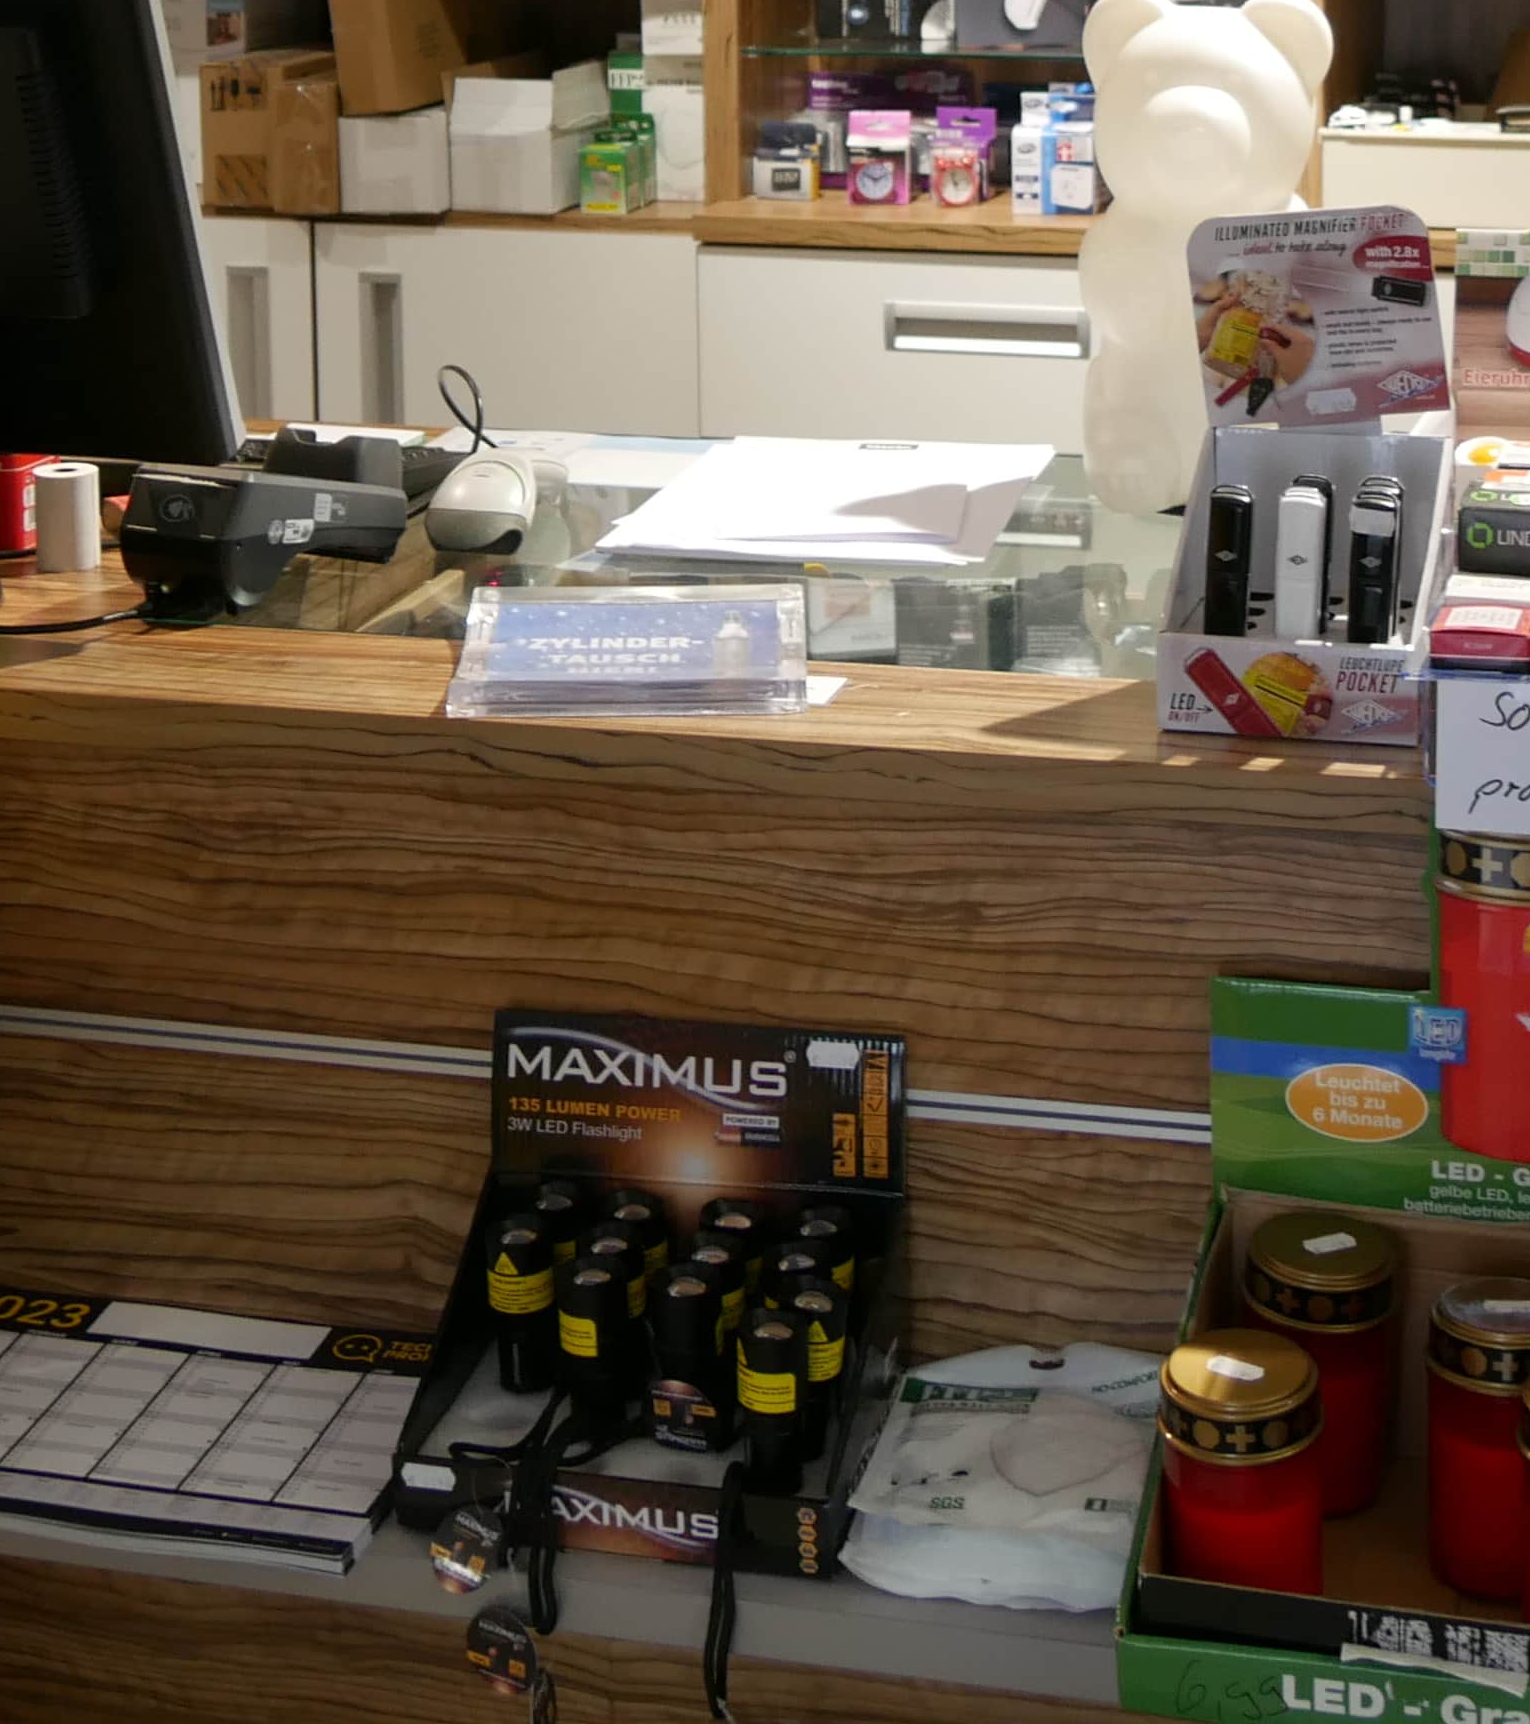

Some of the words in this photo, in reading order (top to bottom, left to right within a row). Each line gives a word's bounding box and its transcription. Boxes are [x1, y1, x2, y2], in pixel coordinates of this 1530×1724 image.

[1215, 222, 1289, 242] ILLUMINATED
[1294, 218, 1358, 235] MAGNIFIER
[1365, 246, 1391, 258] with
[1463, 371, 1530, 387] Eieruhr
[550, 652, 681, 664] TAUSCH
[1340, 657, 1404, 672] LEUCHTLUPE
[1336, 671, 1399, 694] POCKET
[1170, 693, 1195, 711] LED
[1168, 711, 1200, 722] ON/OFF
[1415, 1014, 1463, 1049] LED
[507, 1043, 788, 1097] MAXIMUS
[1314, 1072, 1401, 1096] Leuchtet
[509, 1096, 541, 1114] 135
[546, 1098, 609, 1118] LUMEN
[615, 1104, 682, 1122] POWER
[1329, 1091, 1358, 1110] bis
[1363, 1095, 1387, 1112] zu
[1312, 1106, 1325, 1122] 6
[1329, 1107, 1403, 1130] Monate
[507, 1117, 533, 1132] 3W
[536, 1118, 569, 1135] LED
[572, 1121, 643, 1141] Flashlight
[1431, 1160, 1486, 1182] LED
[1429, 1184, 1472, 1200] gelbe
[1477, 1188, 1513, 1204] LED,
[930, 1496, 965, 1509] SGS
